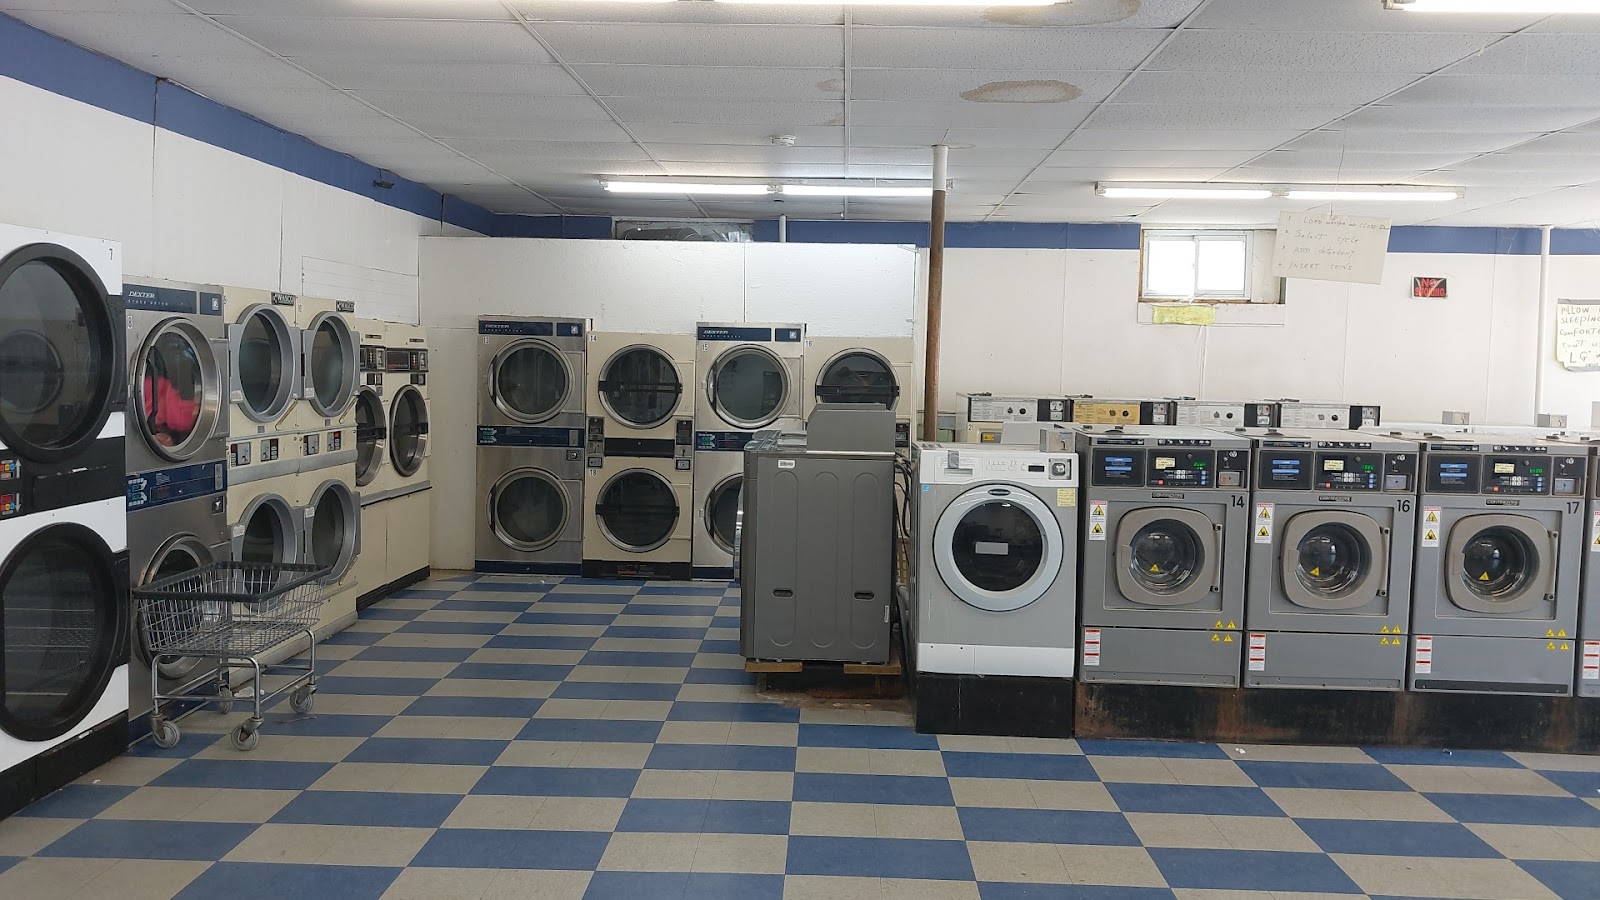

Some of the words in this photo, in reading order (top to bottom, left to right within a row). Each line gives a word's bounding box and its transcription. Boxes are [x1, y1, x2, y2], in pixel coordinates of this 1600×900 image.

[128, 290, 156, 299] DEXTER
[1231, 494, 1245, 508] 14
[1396, 499, 1411, 513] 16
[1566, 501, 1580, 515] 17
